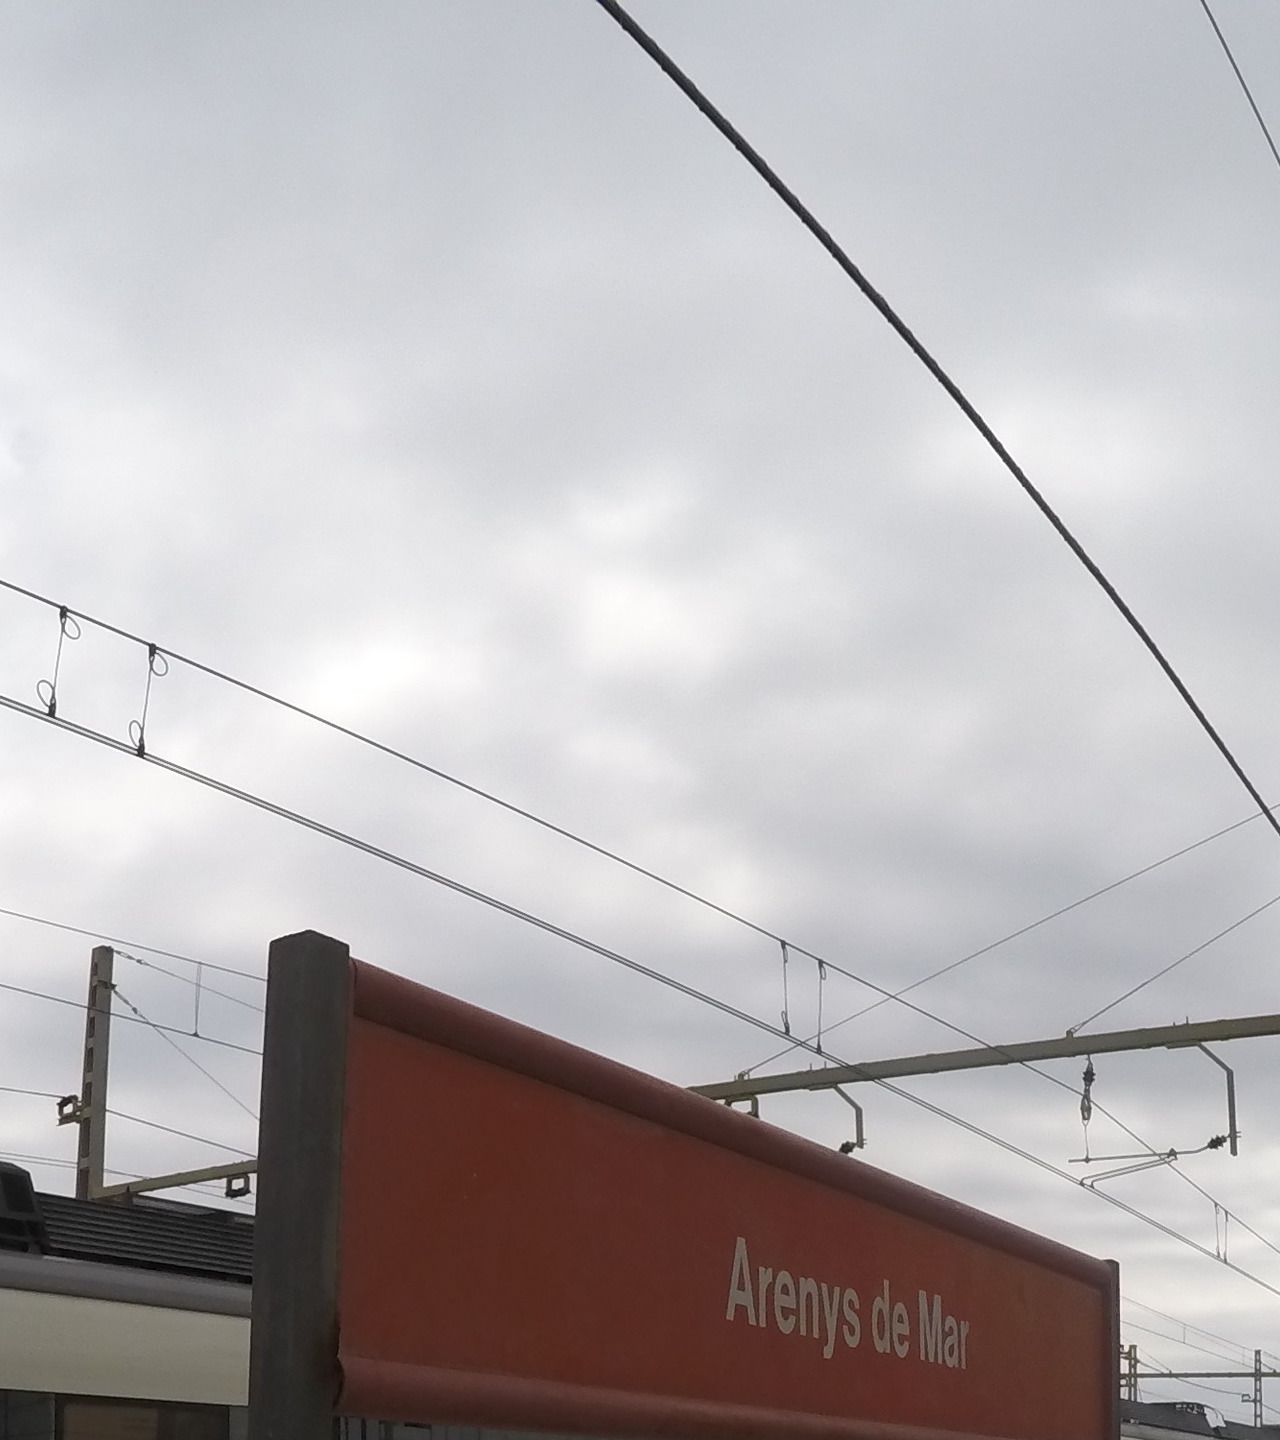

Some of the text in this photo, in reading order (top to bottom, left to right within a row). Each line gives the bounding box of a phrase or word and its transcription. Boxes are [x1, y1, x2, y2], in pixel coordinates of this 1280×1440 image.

[726, 1236, 969, 1369] Arenys de Mar
